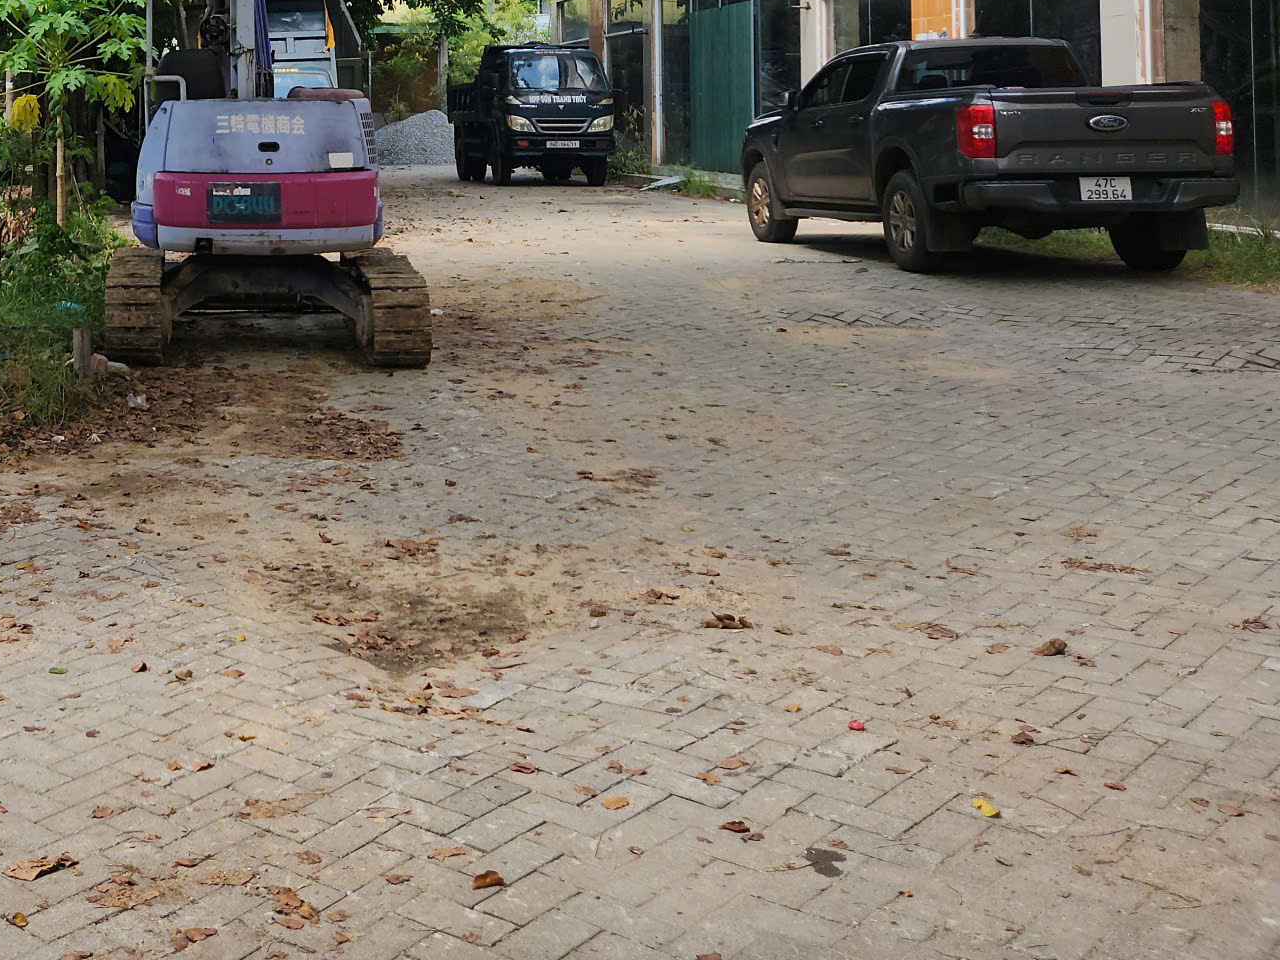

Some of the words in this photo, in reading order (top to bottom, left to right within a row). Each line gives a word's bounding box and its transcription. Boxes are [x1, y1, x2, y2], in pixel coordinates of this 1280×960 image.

[1099, 118, 1120, 128] Ford
[1018, 152, 1197, 165] RANGER
[1094, 177, 1117, 189] 47C
[1086, 189, 1127, 200] 299.64
